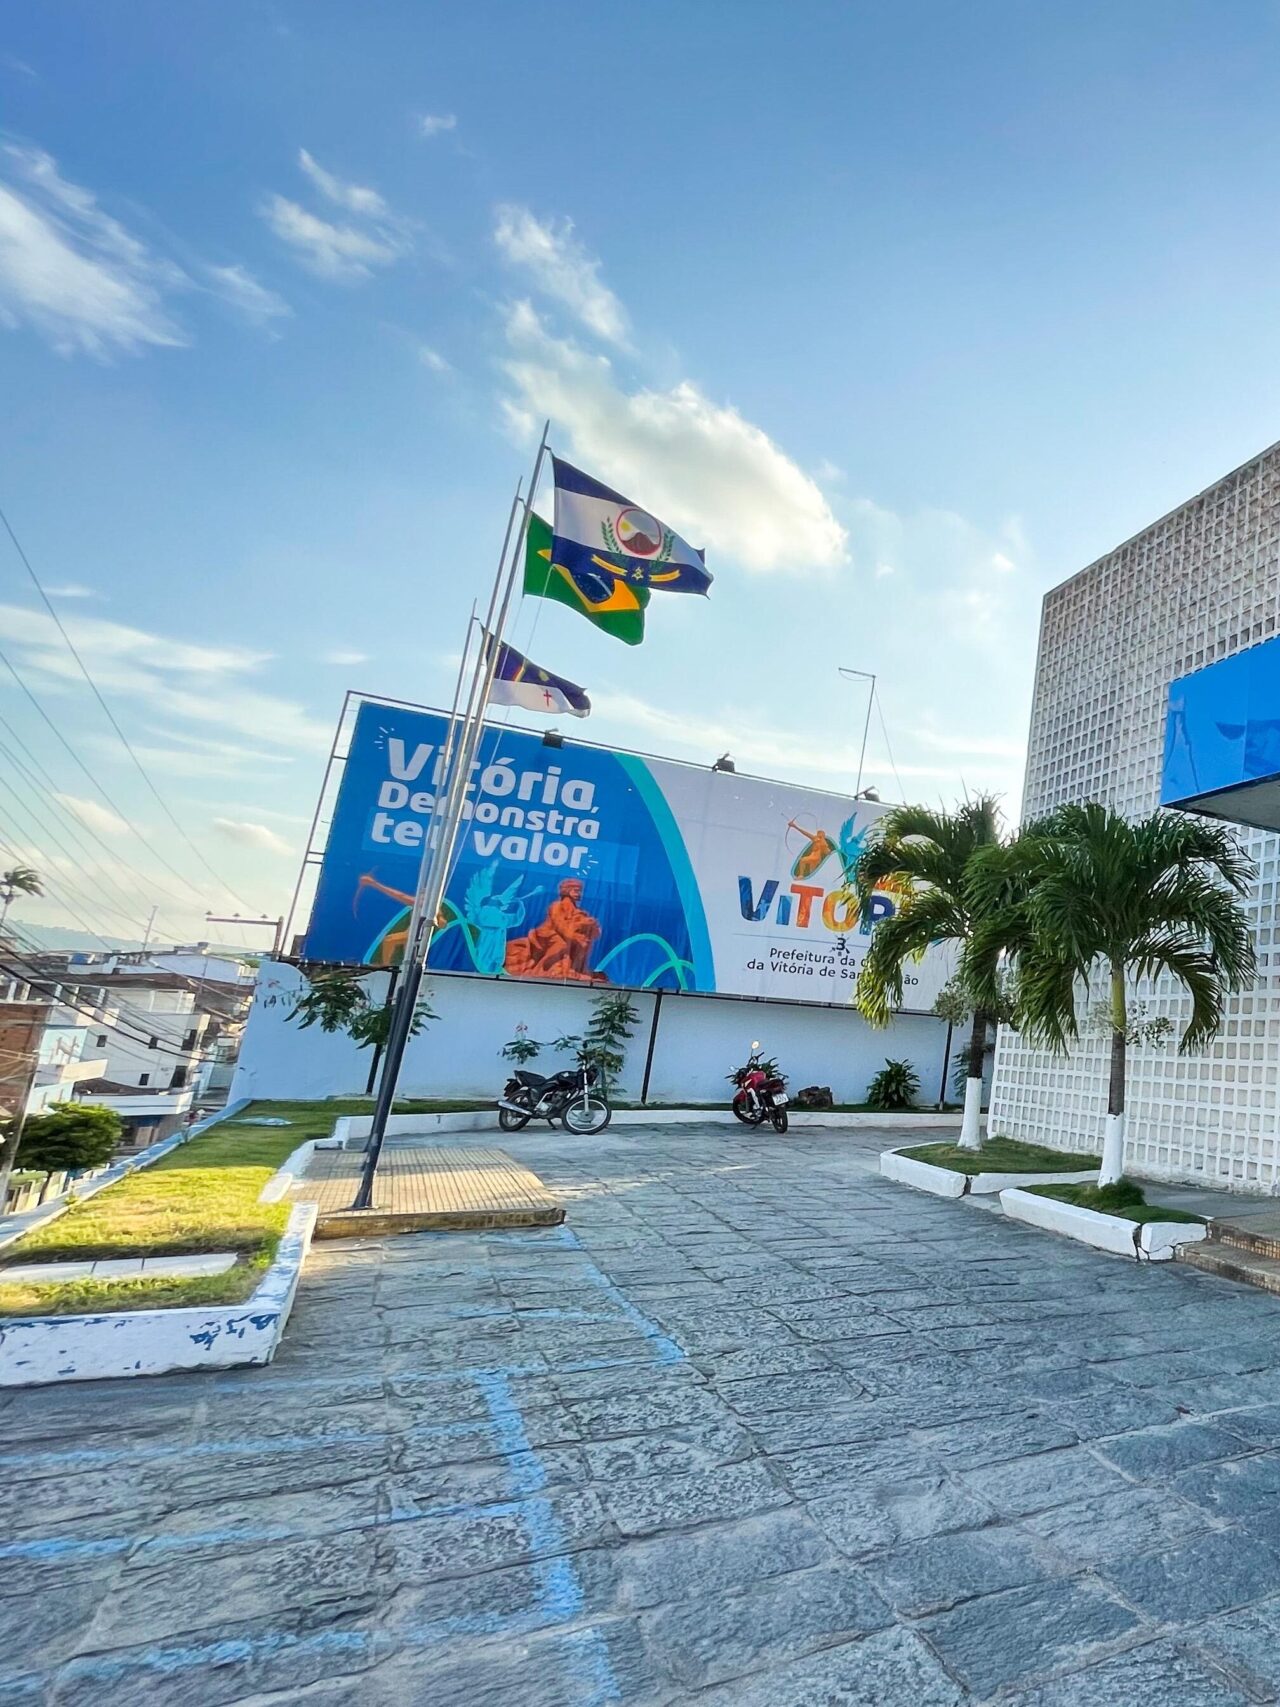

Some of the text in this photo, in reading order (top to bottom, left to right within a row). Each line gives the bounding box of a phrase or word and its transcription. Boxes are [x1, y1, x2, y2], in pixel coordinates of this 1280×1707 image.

[473, 831, 589, 870] valor
[746, 958, 764, 971] da
[770, 961, 814, 976] Vitória
[819, 965, 836, 978] de
[769, 947, 835, 965] Prefeitura
[840, 954, 856, 968] da
